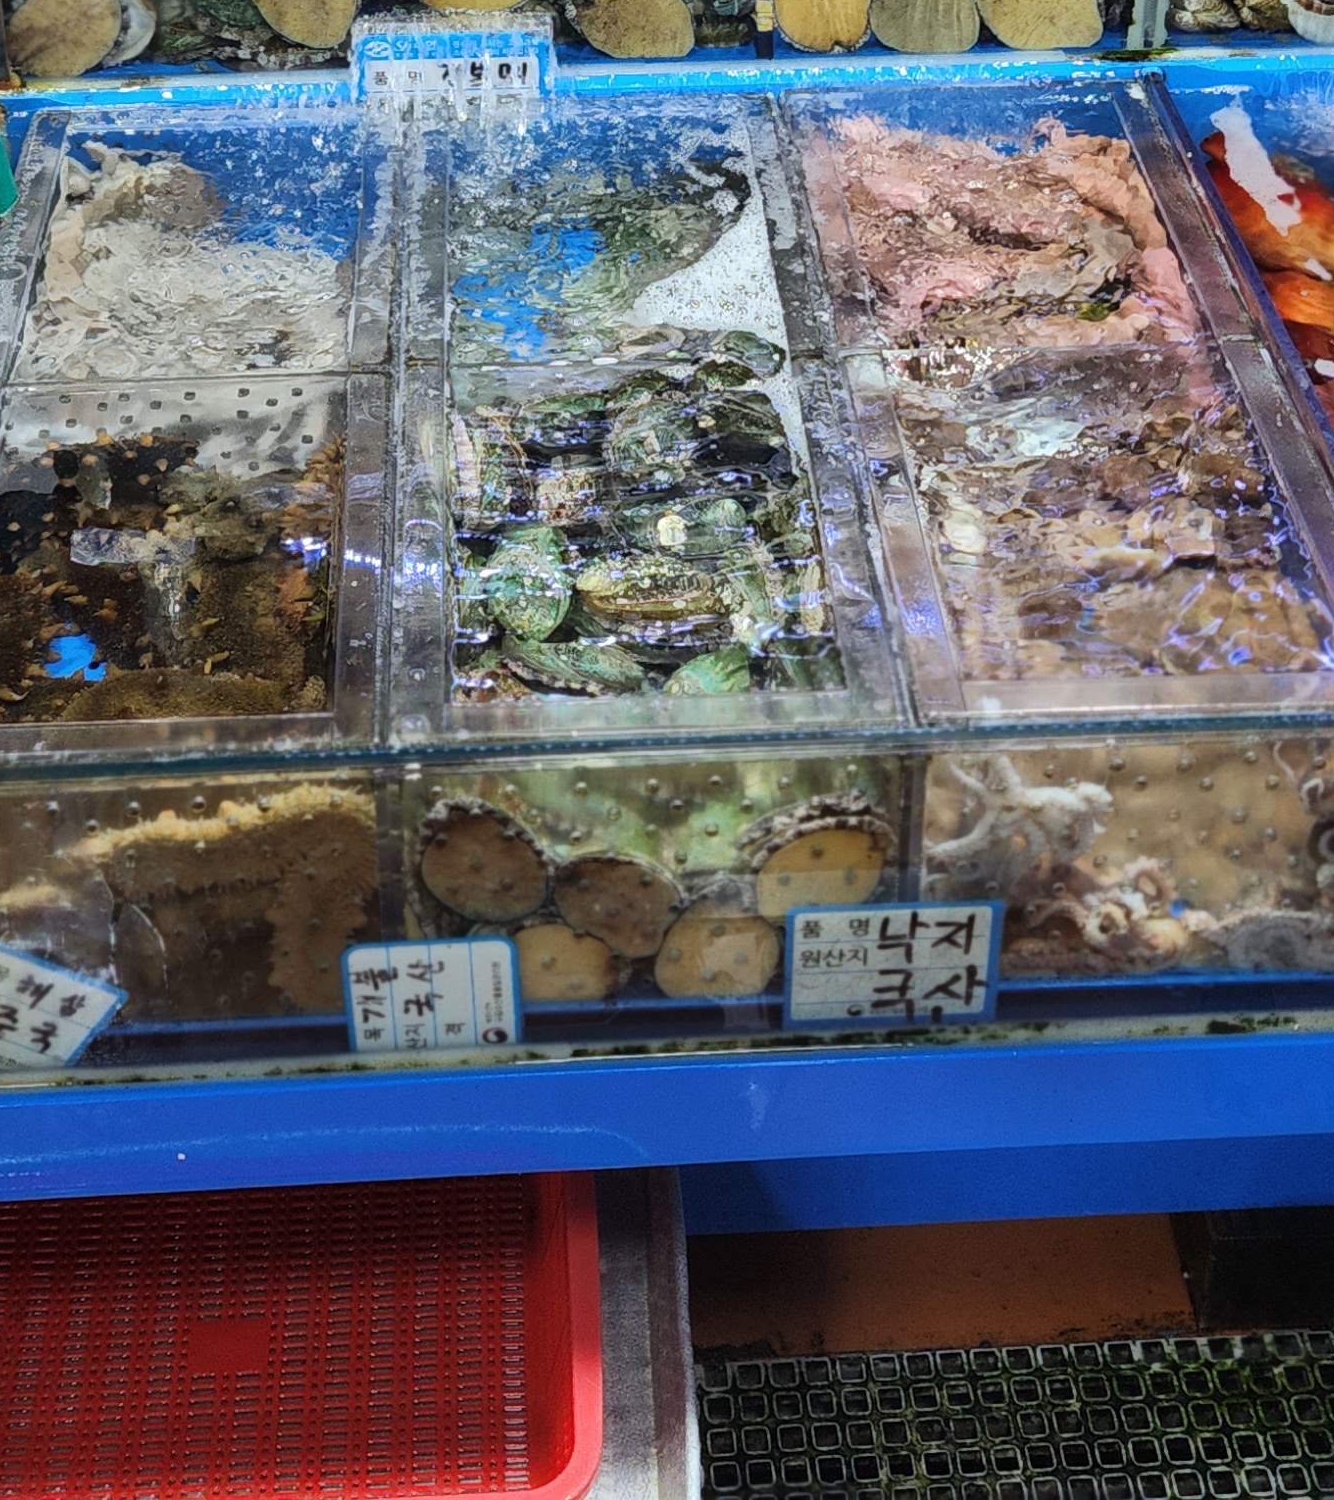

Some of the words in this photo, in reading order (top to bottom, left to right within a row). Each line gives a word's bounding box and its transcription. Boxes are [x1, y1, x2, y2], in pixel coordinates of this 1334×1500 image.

[799, 919, 824, 939] 품
[848, 917, 871, 936] 명
[876, 910, 977, 964] 낙지
[799, 946, 869, 969] 원산지
[348, 965, 399, 1024] 개불
[402, 958, 445, 1017] 국산
